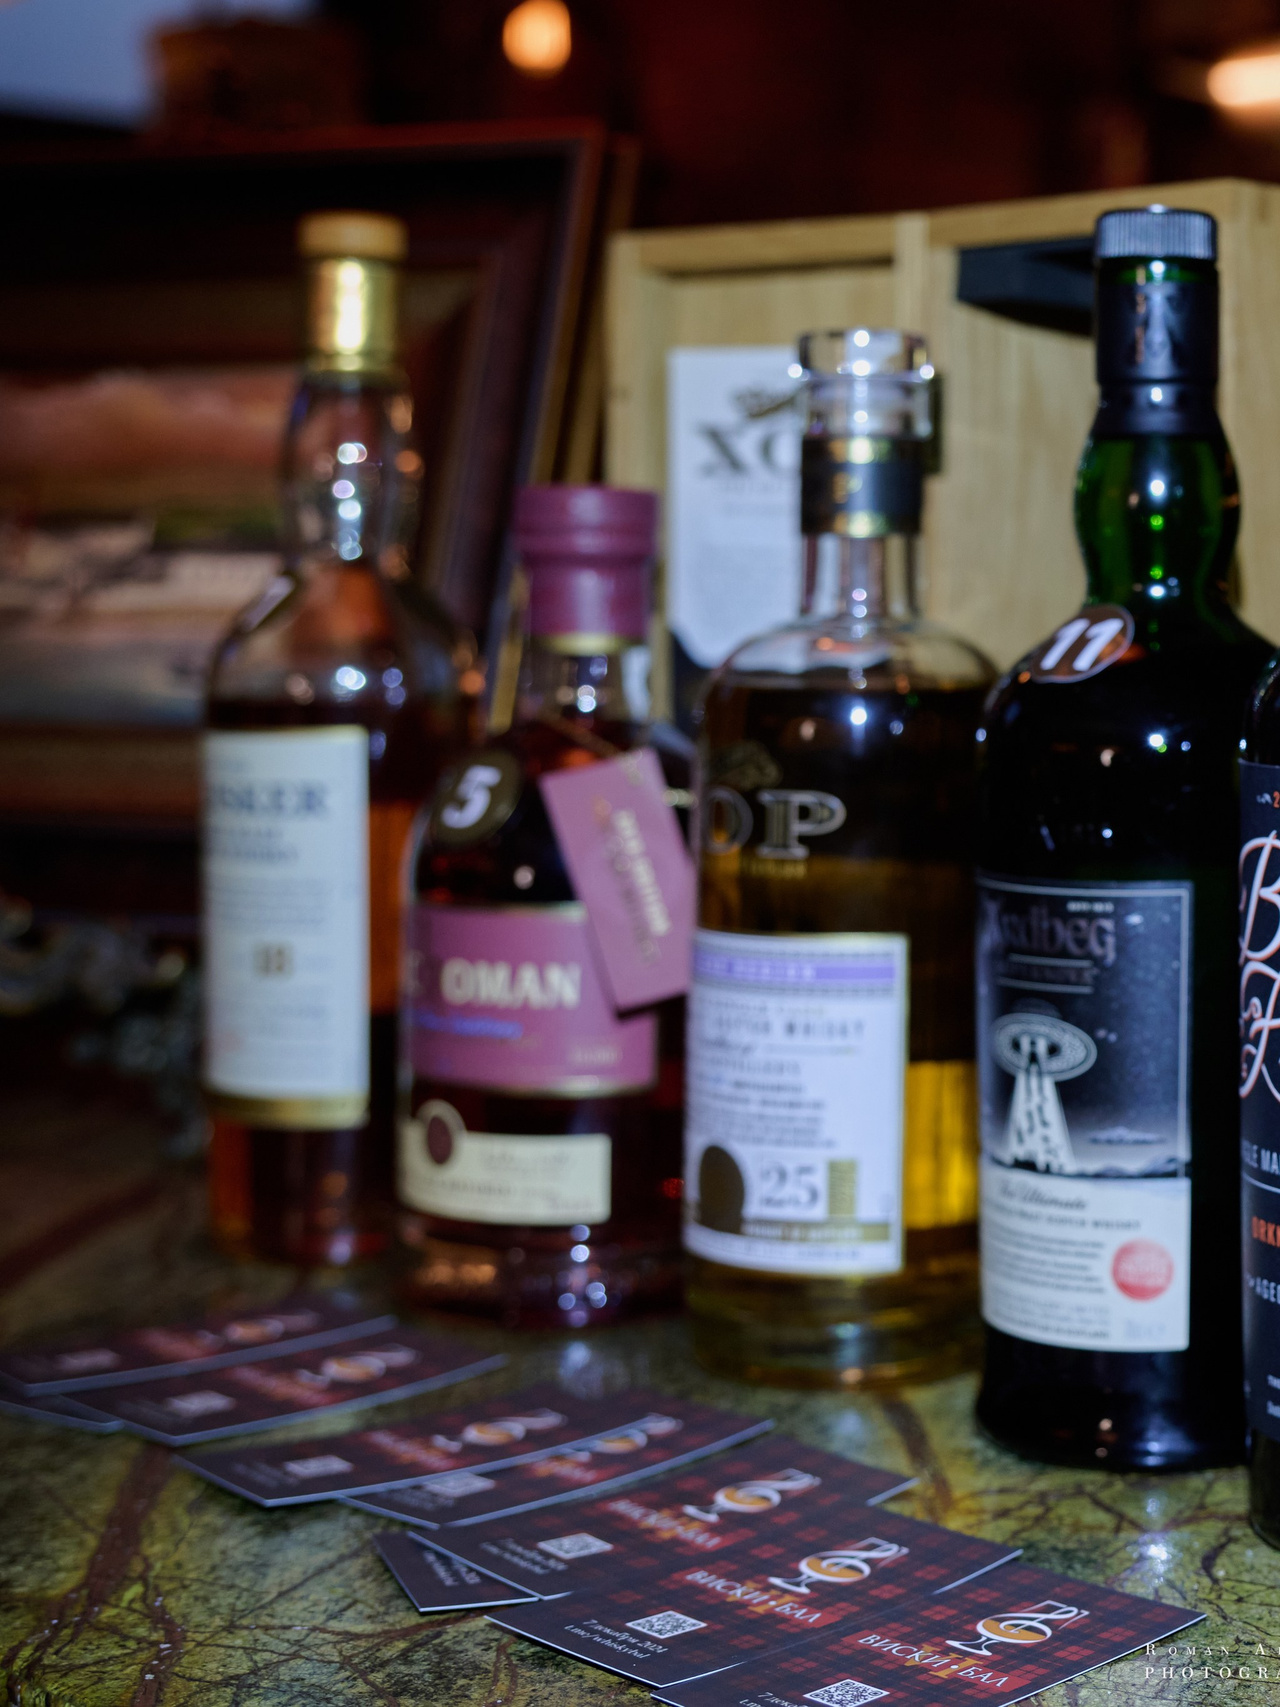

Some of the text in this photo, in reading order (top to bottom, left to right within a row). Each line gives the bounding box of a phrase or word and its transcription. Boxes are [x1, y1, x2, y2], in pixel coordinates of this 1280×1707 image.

[1040, 618, 1124, 671] 11
[442, 765, 500, 829] 5
[685, 1570, 822, 1623] ВИСКИ БАЛ
[857, 1634, 1009, 1687] ВИСКИ БАЛ
